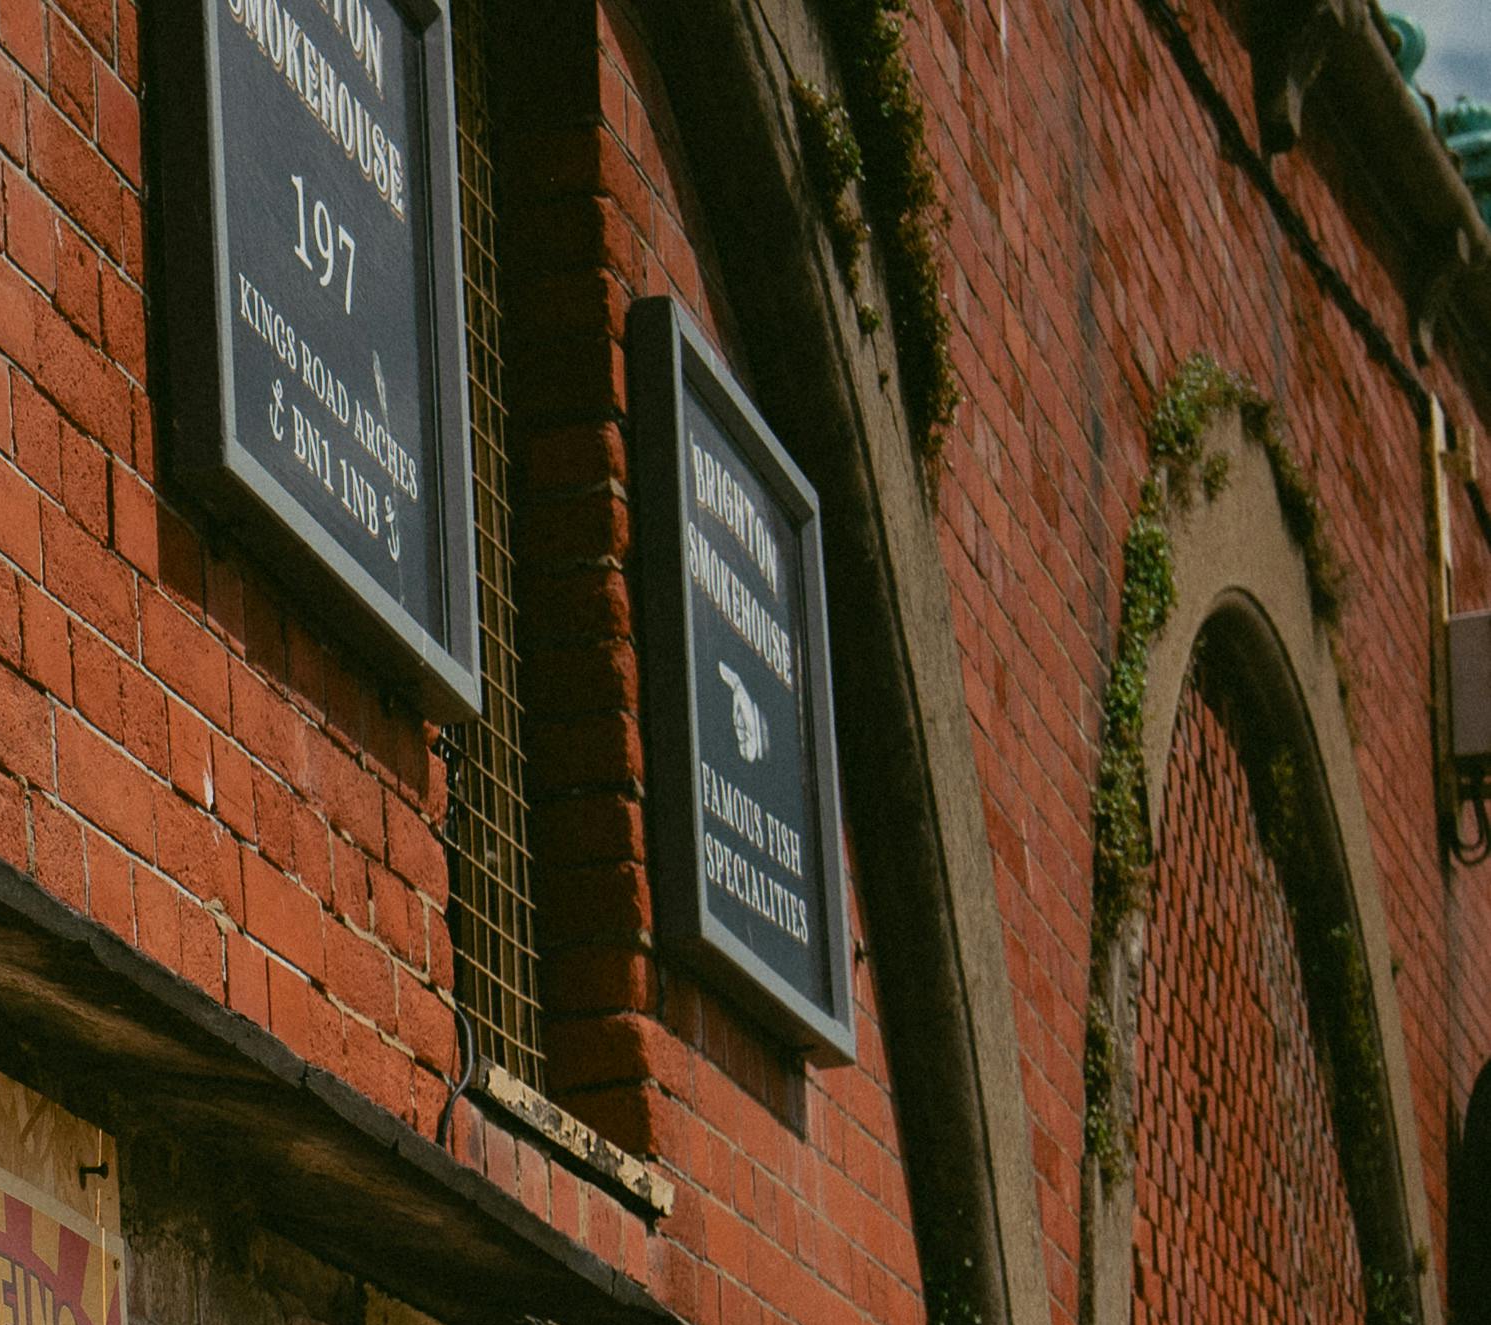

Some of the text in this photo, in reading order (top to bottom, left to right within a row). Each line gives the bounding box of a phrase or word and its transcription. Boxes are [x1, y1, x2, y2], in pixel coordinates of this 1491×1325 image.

[291, 174, 356, 315] 197
[239, 272, 418, 500] KINGS ROAD ARCHES
[292, 405, 379, 536] BN1 1NB
[691, 436, 777, 600] BRIGHTON
[688, 520, 792, 690] SMOKEHOUSE
[701, 761, 802, 878] FAMOUS FISH
[705, 832, 808, 945] SPECIALITIES
